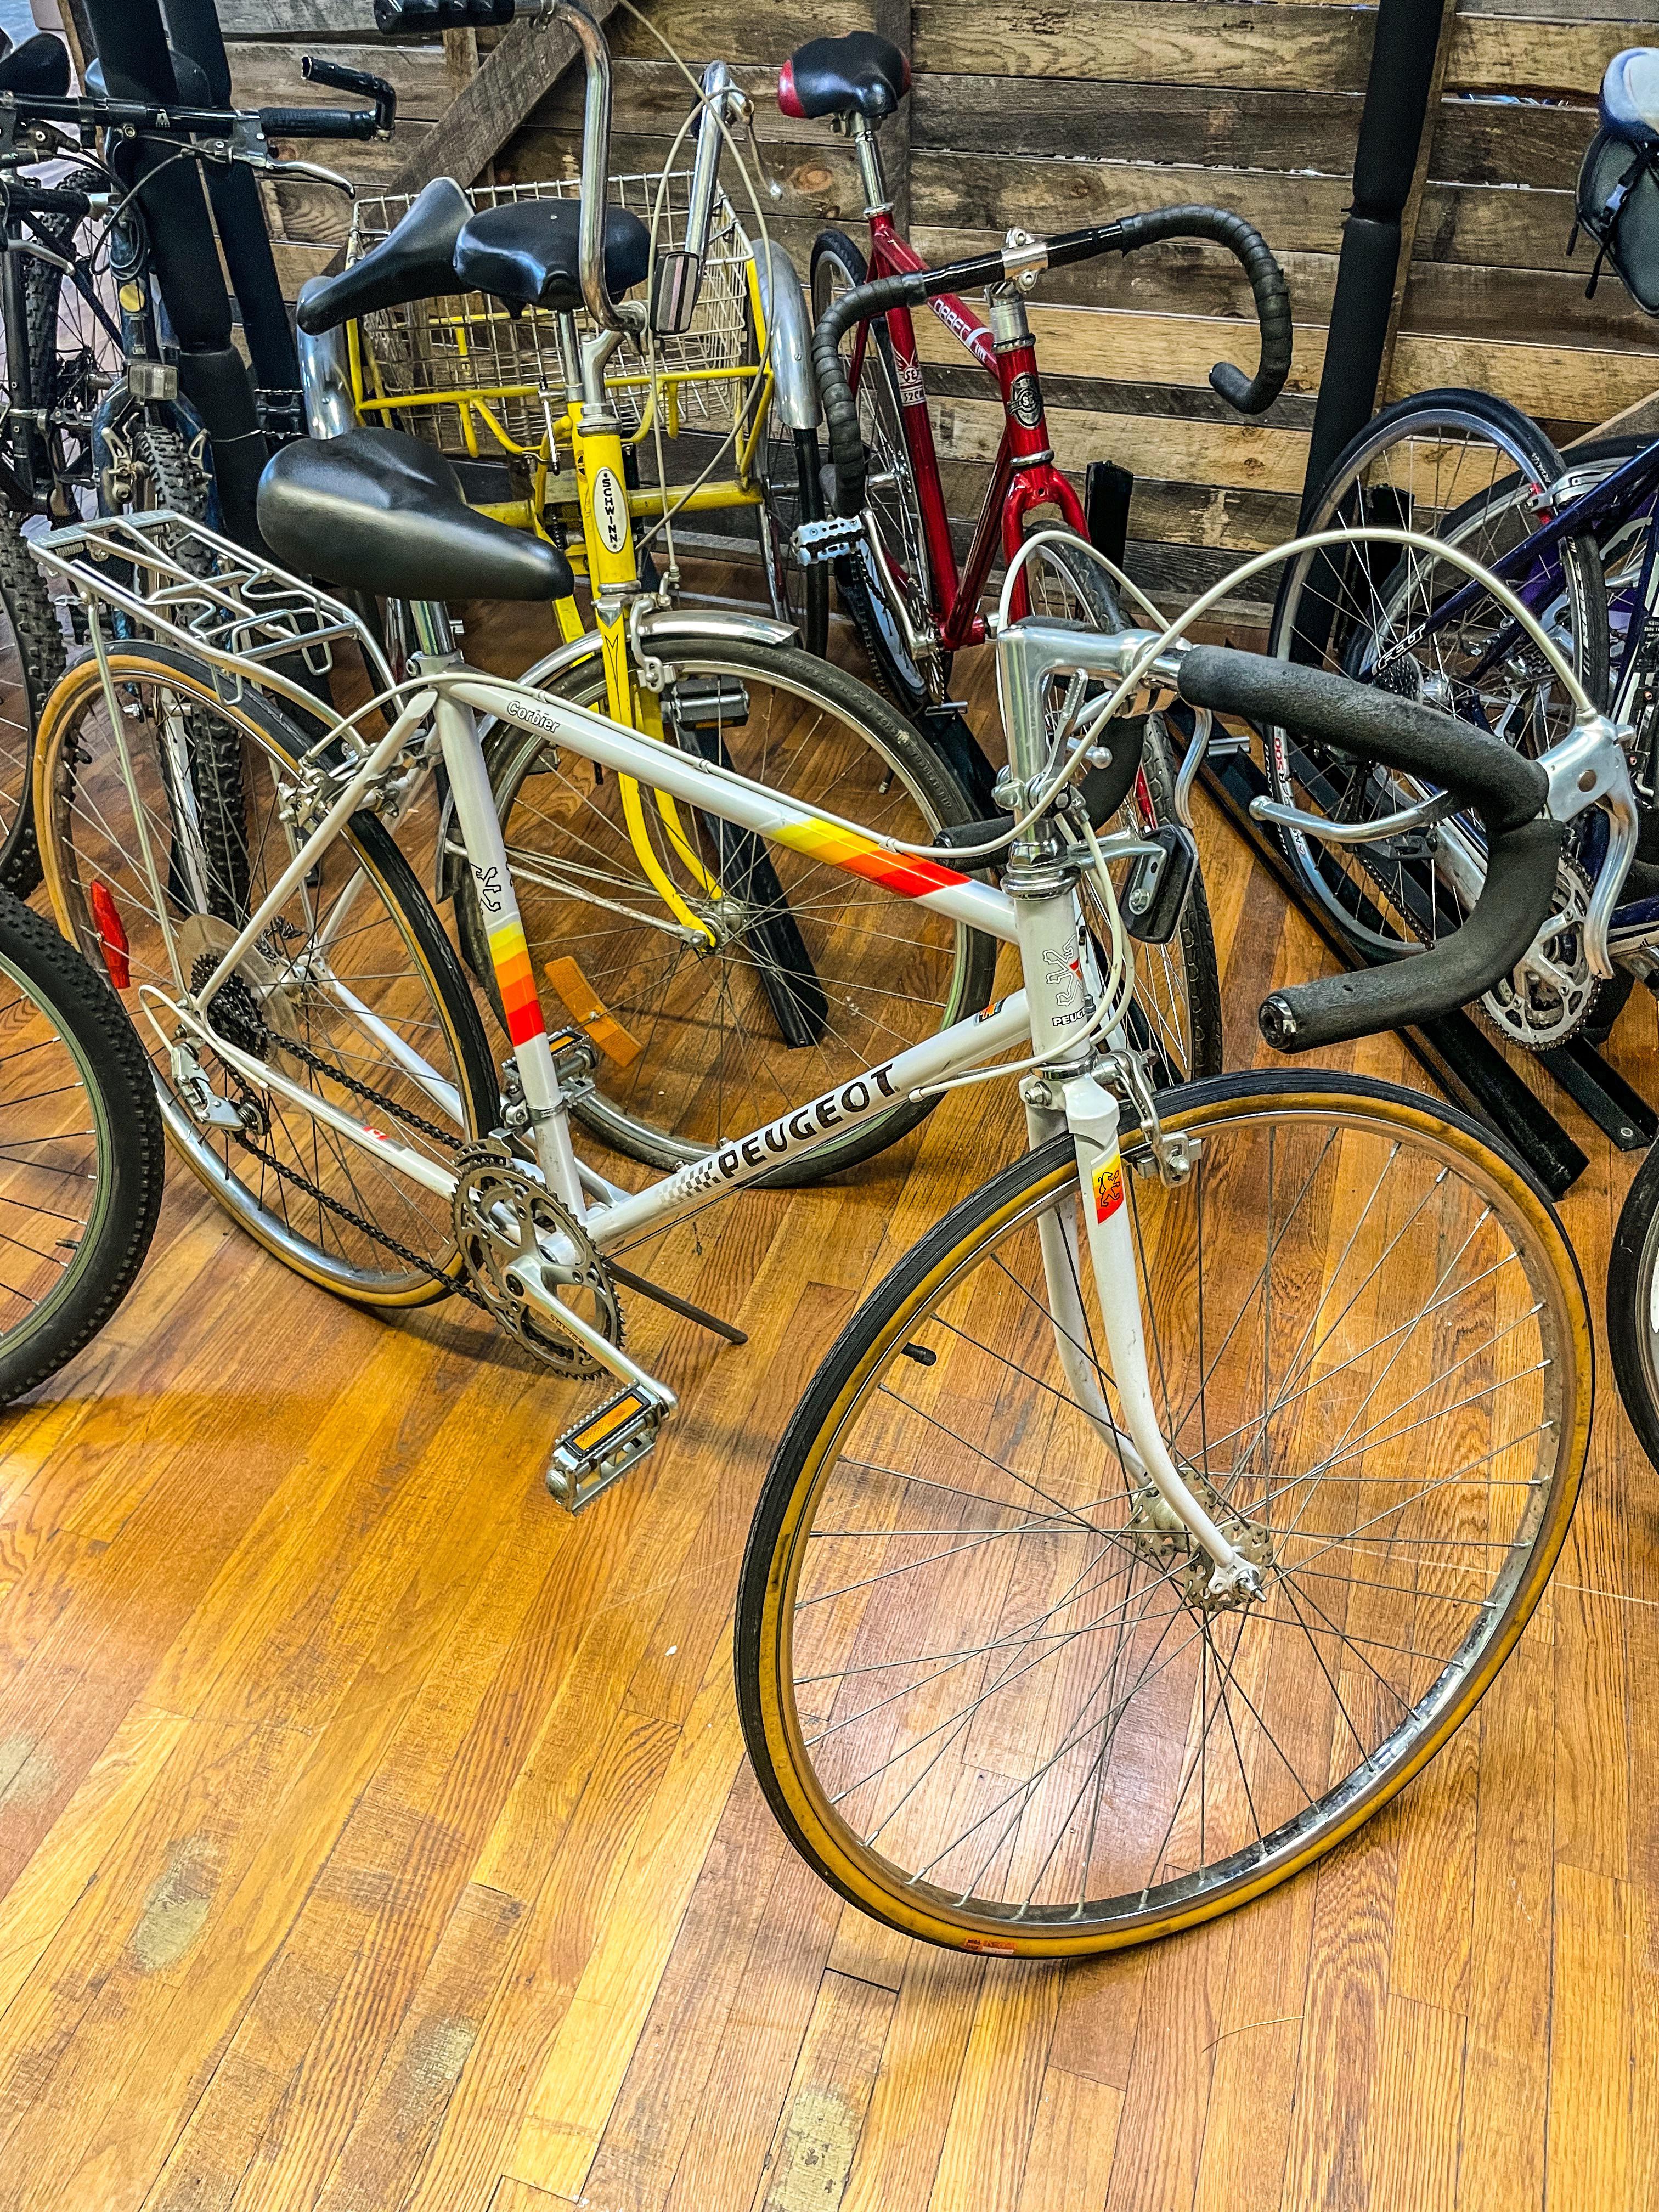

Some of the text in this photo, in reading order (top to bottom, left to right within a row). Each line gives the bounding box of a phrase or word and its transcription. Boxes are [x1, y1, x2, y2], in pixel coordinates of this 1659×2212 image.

[602, 478, 618, 543] SCHWINN
[1378, 623, 1426, 670] FELT
[507, 701, 560, 733] Corbier
[719, 1063, 896, 1179] PEUGEOT
